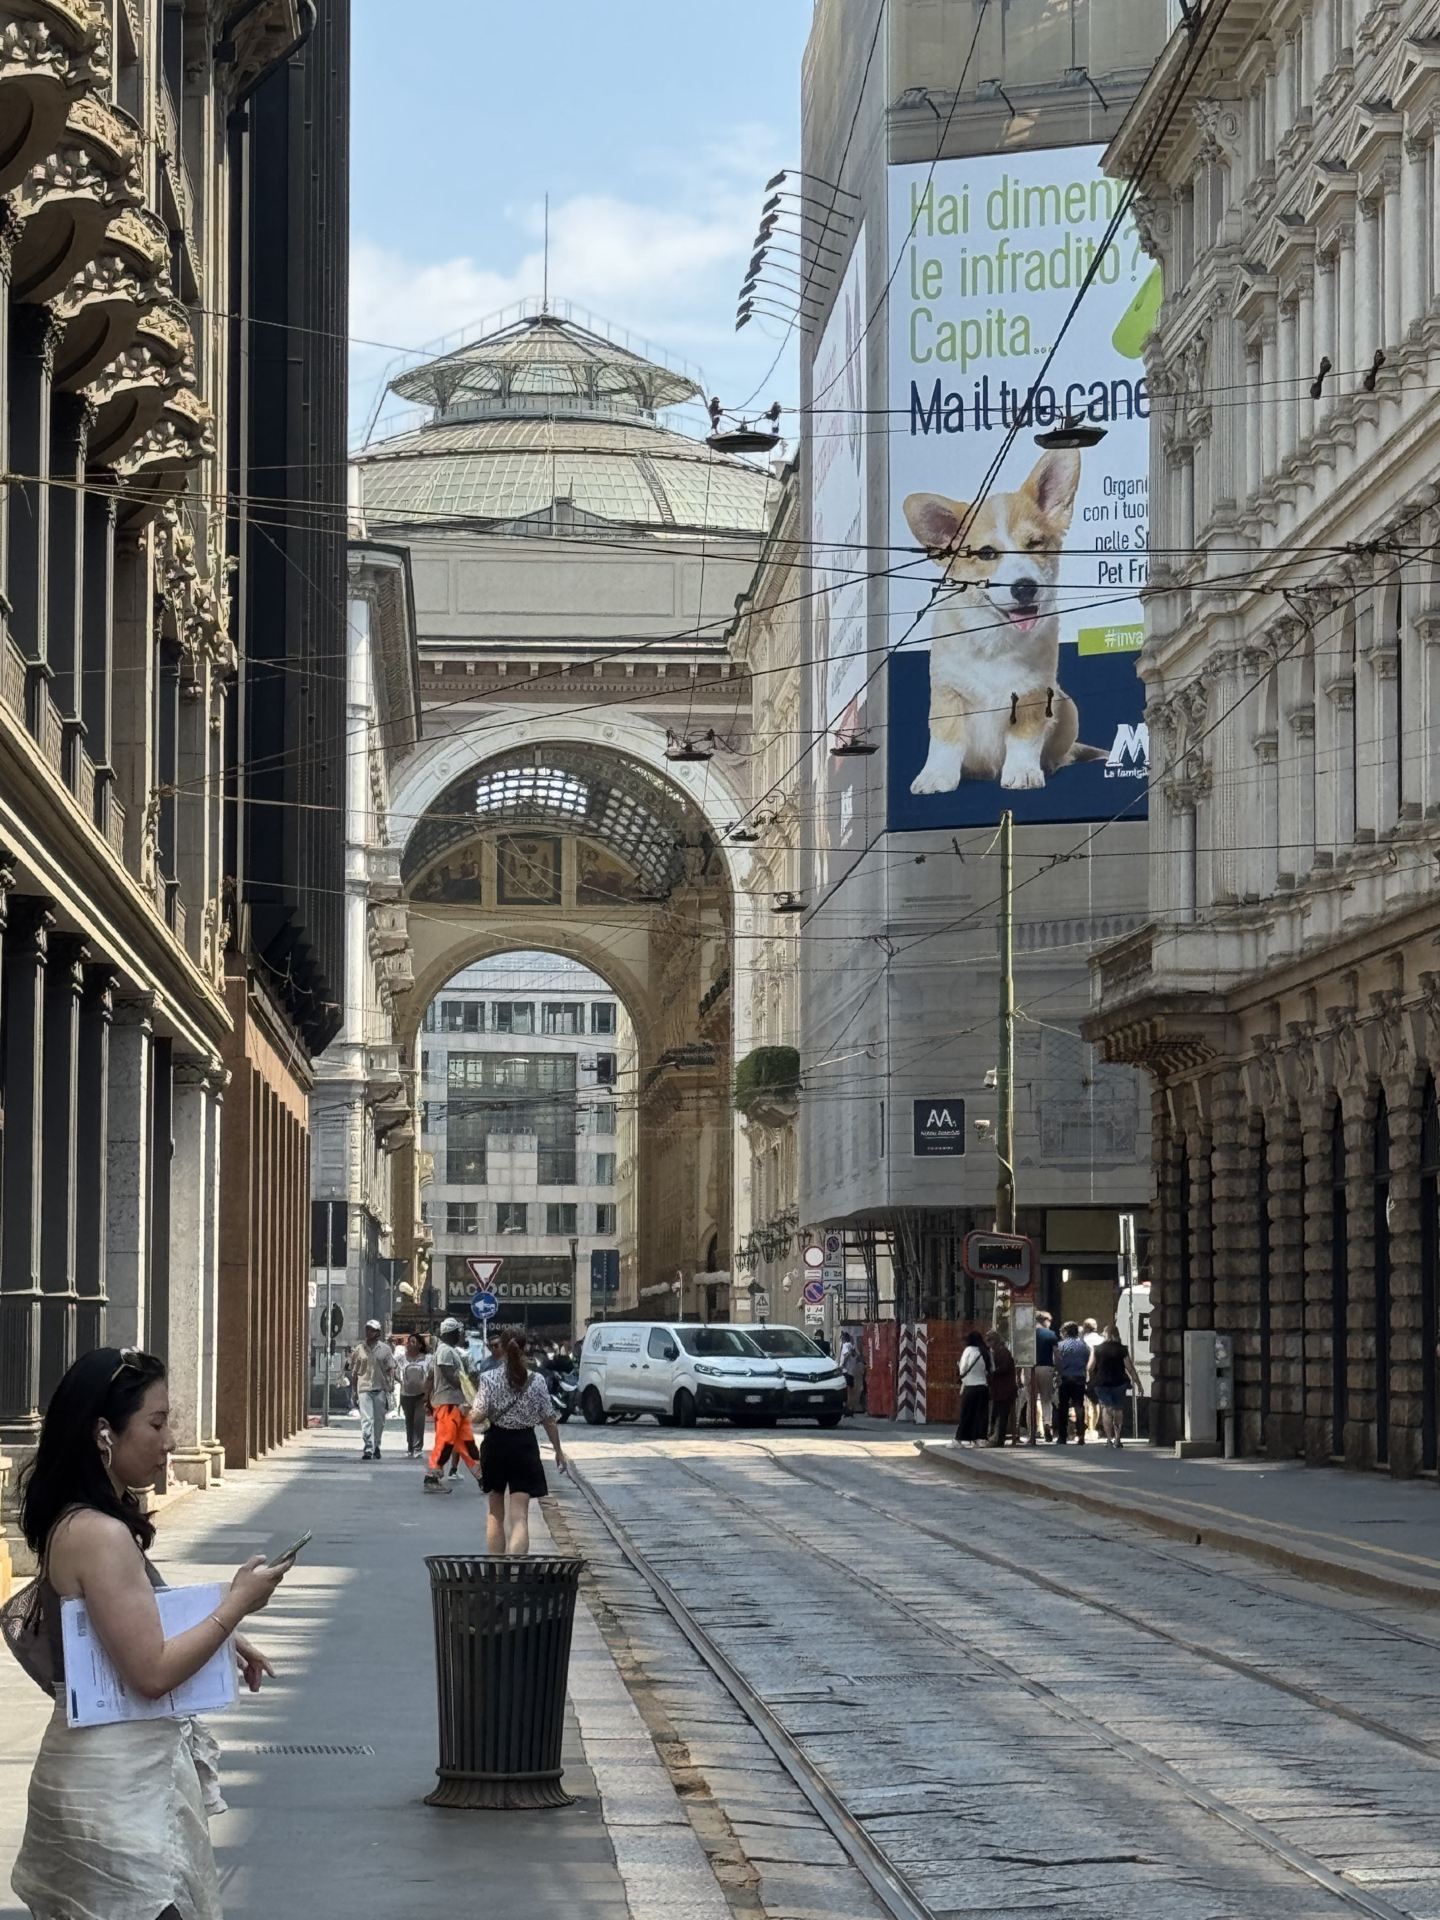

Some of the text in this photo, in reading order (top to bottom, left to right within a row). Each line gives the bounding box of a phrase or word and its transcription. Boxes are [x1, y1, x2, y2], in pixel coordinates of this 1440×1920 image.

[911, 181, 969, 238] Hai
[911, 245, 943, 300] le
[910, 375, 1150, 436] Ma il tuo cane
[1083, 505, 1109, 522] con
[1114, 501, 1118, 520] i
[1096, 530, 1129, 551] nelle
[1098, 560, 1123, 584] Pet
[1104, 769, 1115, 778] La
